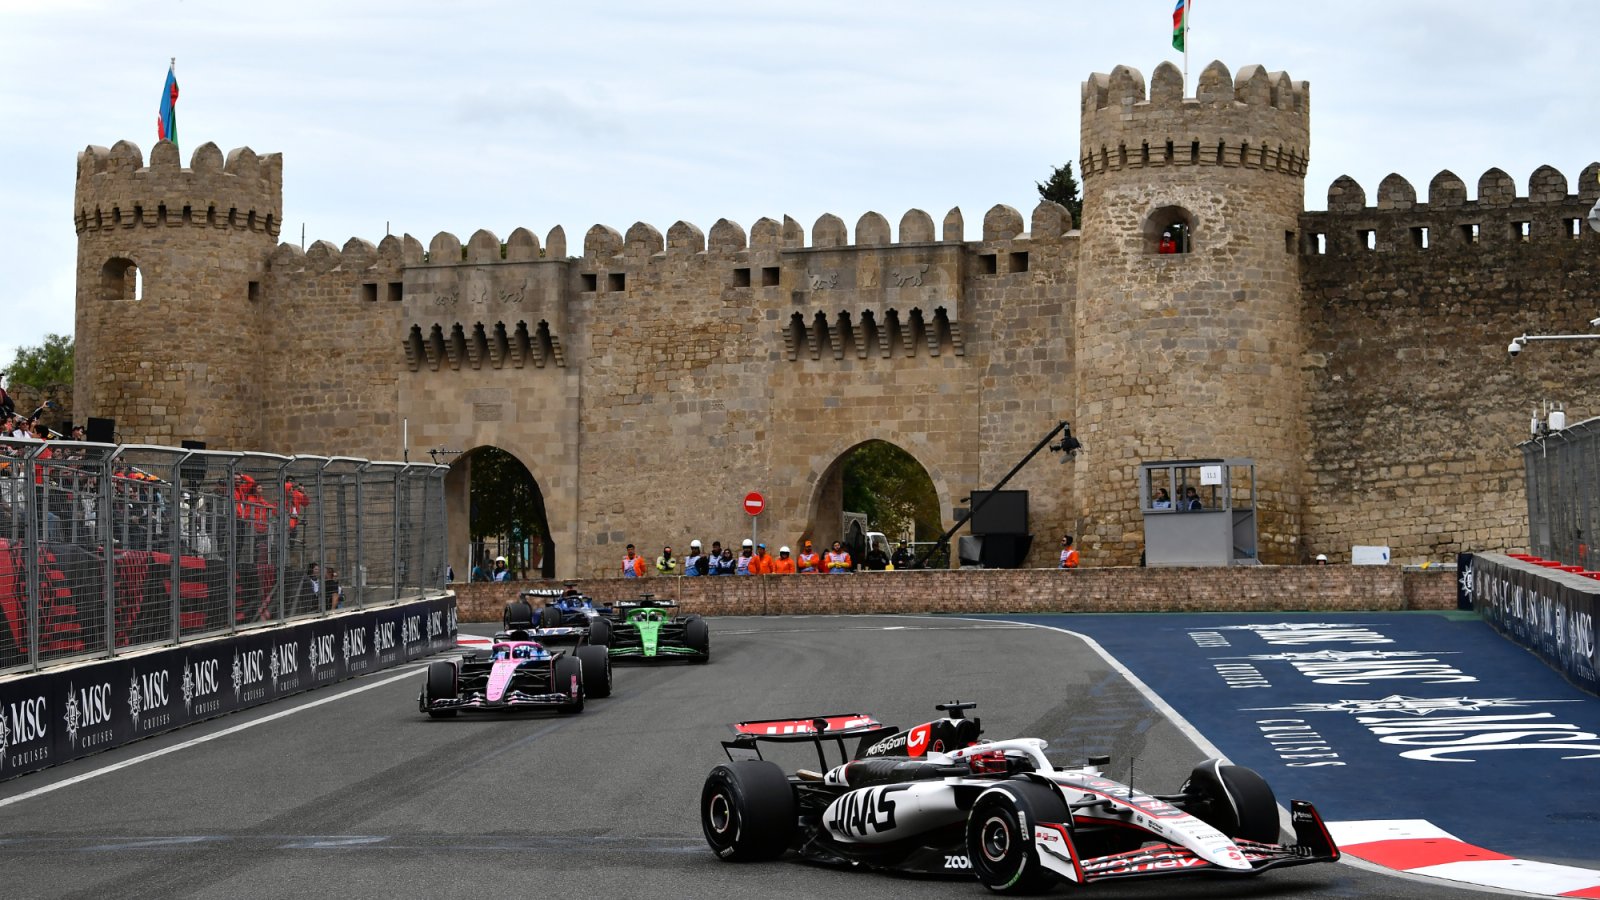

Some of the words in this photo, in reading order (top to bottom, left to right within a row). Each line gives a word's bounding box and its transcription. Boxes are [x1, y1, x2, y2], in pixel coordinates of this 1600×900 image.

[350, 627, 366, 656] MSC
[380, 621, 395, 649] MSC
[408, 614, 421, 642] MSC
[279, 641, 299, 676] MSC
[317, 634, 335, 665] MSC
[194, 658, 219, 697] MSC
[242, 649, 264, 685] MSC
[81, 682, 112, 728] MSC
[142, 669, 169, 711] MSC
[11, 696, 47, 745] MSC
[143, 713, 170, 730] CRUISES
[195, 699, 220, 716] CRUISES
[82, 729, 113, 748] CRUISES
[866, 736, 906, 756] MoneyGram
[1256, 719, 1347, 767] CRUISES
[1355, 712, 1600, 762] MSC
[12, 746, 48, 768] CRUISES
[829, 784, 915, 836] HAAS
